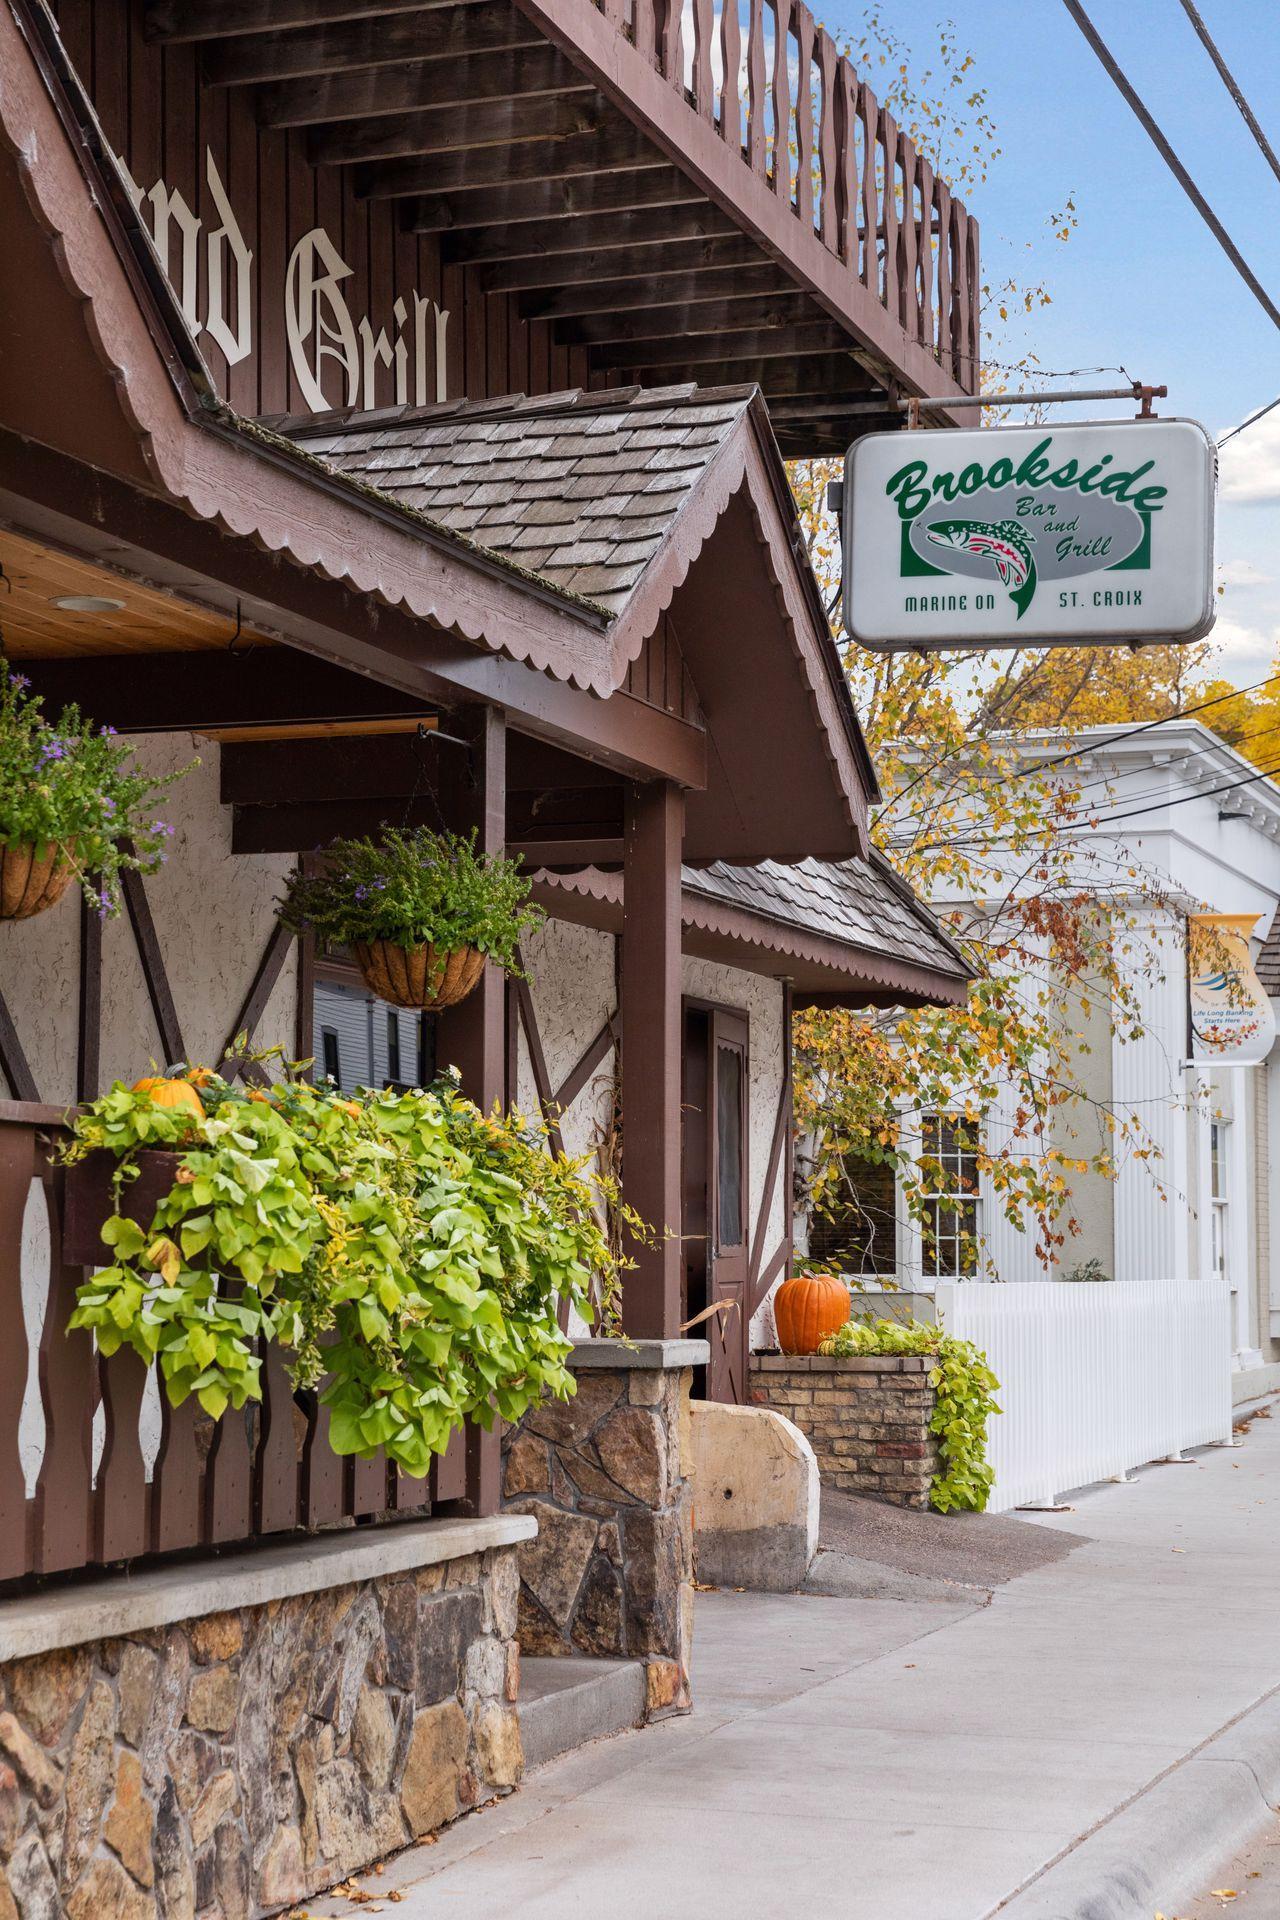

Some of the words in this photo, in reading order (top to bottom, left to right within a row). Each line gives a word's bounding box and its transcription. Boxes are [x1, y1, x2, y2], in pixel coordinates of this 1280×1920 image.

[117, 143, 254, 366] nd
[285, 227, 451, 413] Grill
[885, 437, 1168, 519] Brookside
[1015, 496, 1058, 517] Bar
[1043, 515, 1079, 533] and
[1055, 536, 1112, 562] Grill
[905, 595, 967, 612] MARINE
[976, 594, 995, 610] ON
[1059, 592, 1085, 608] ST.
[1093, 590, 1143, 606] CROIX
